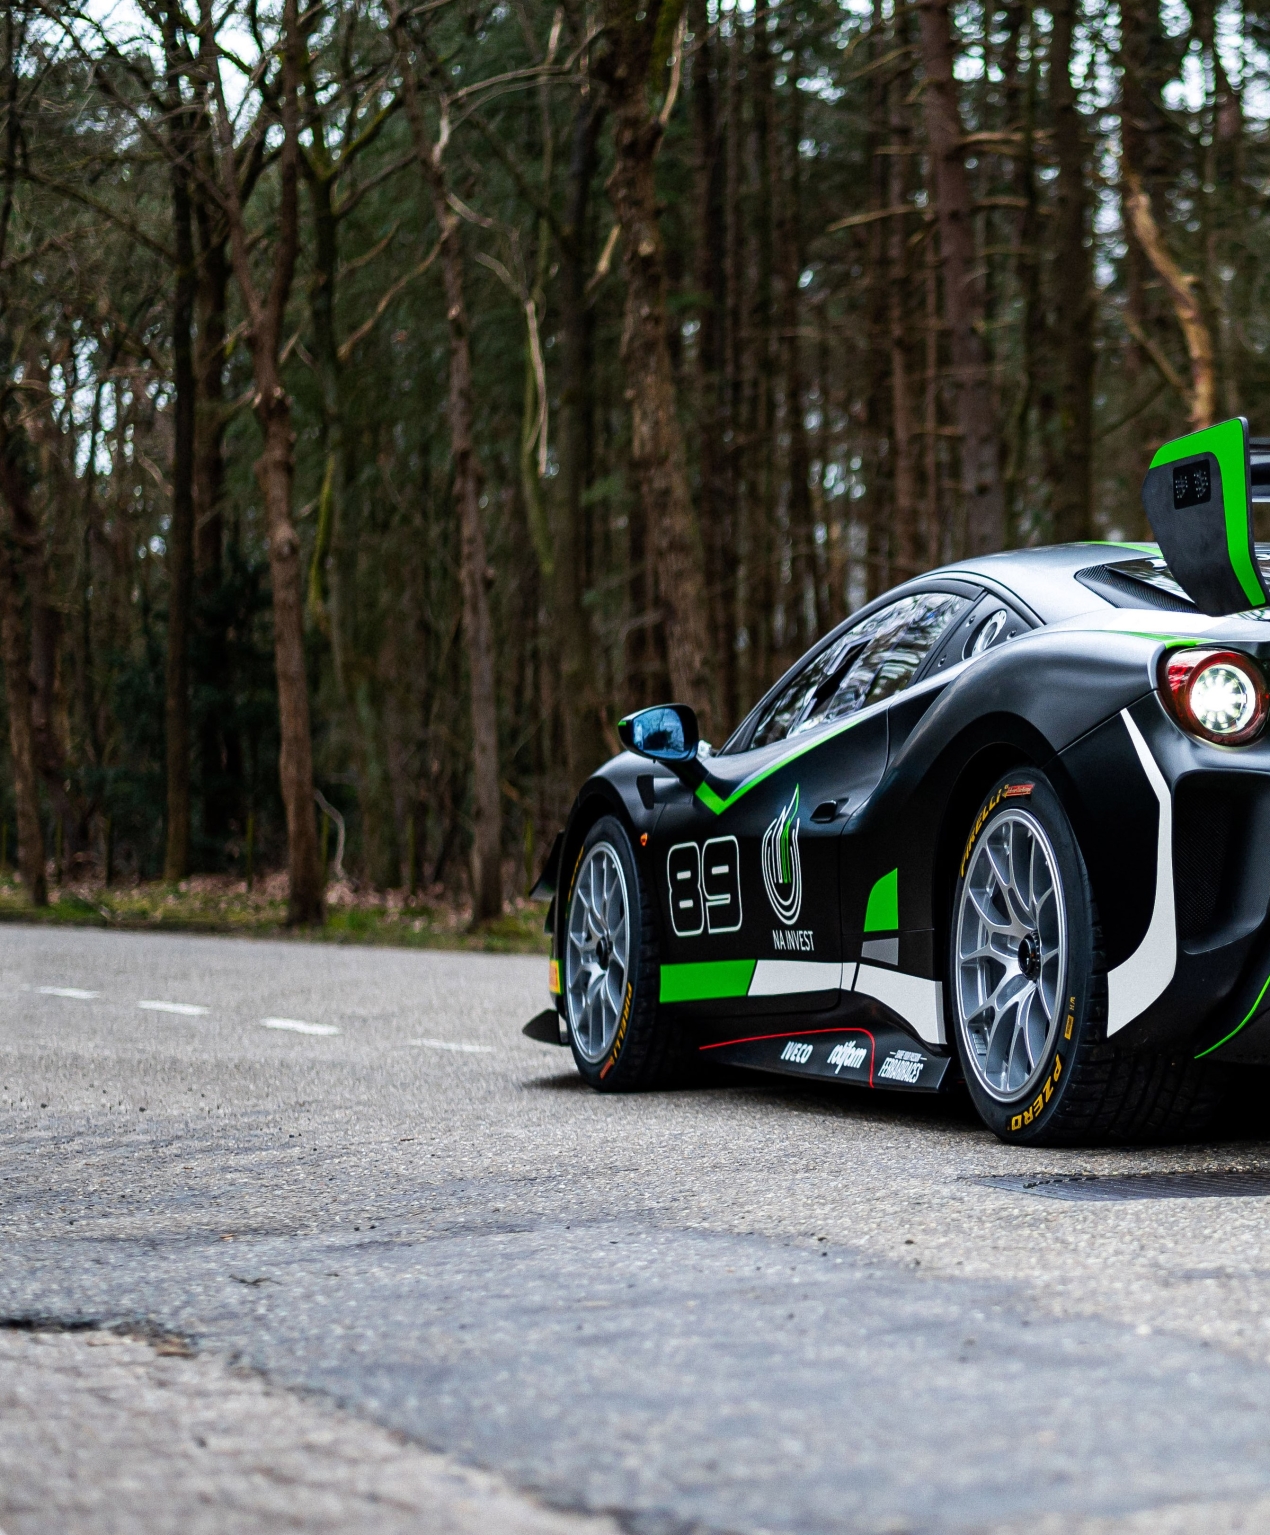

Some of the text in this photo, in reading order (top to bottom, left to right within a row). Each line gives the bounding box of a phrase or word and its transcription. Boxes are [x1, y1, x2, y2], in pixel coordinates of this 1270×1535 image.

[667, 835, 743, 937] 89
[772, 930, 815, 951] NA INVEST
[780, 1041, 813, 1064] IVECO
